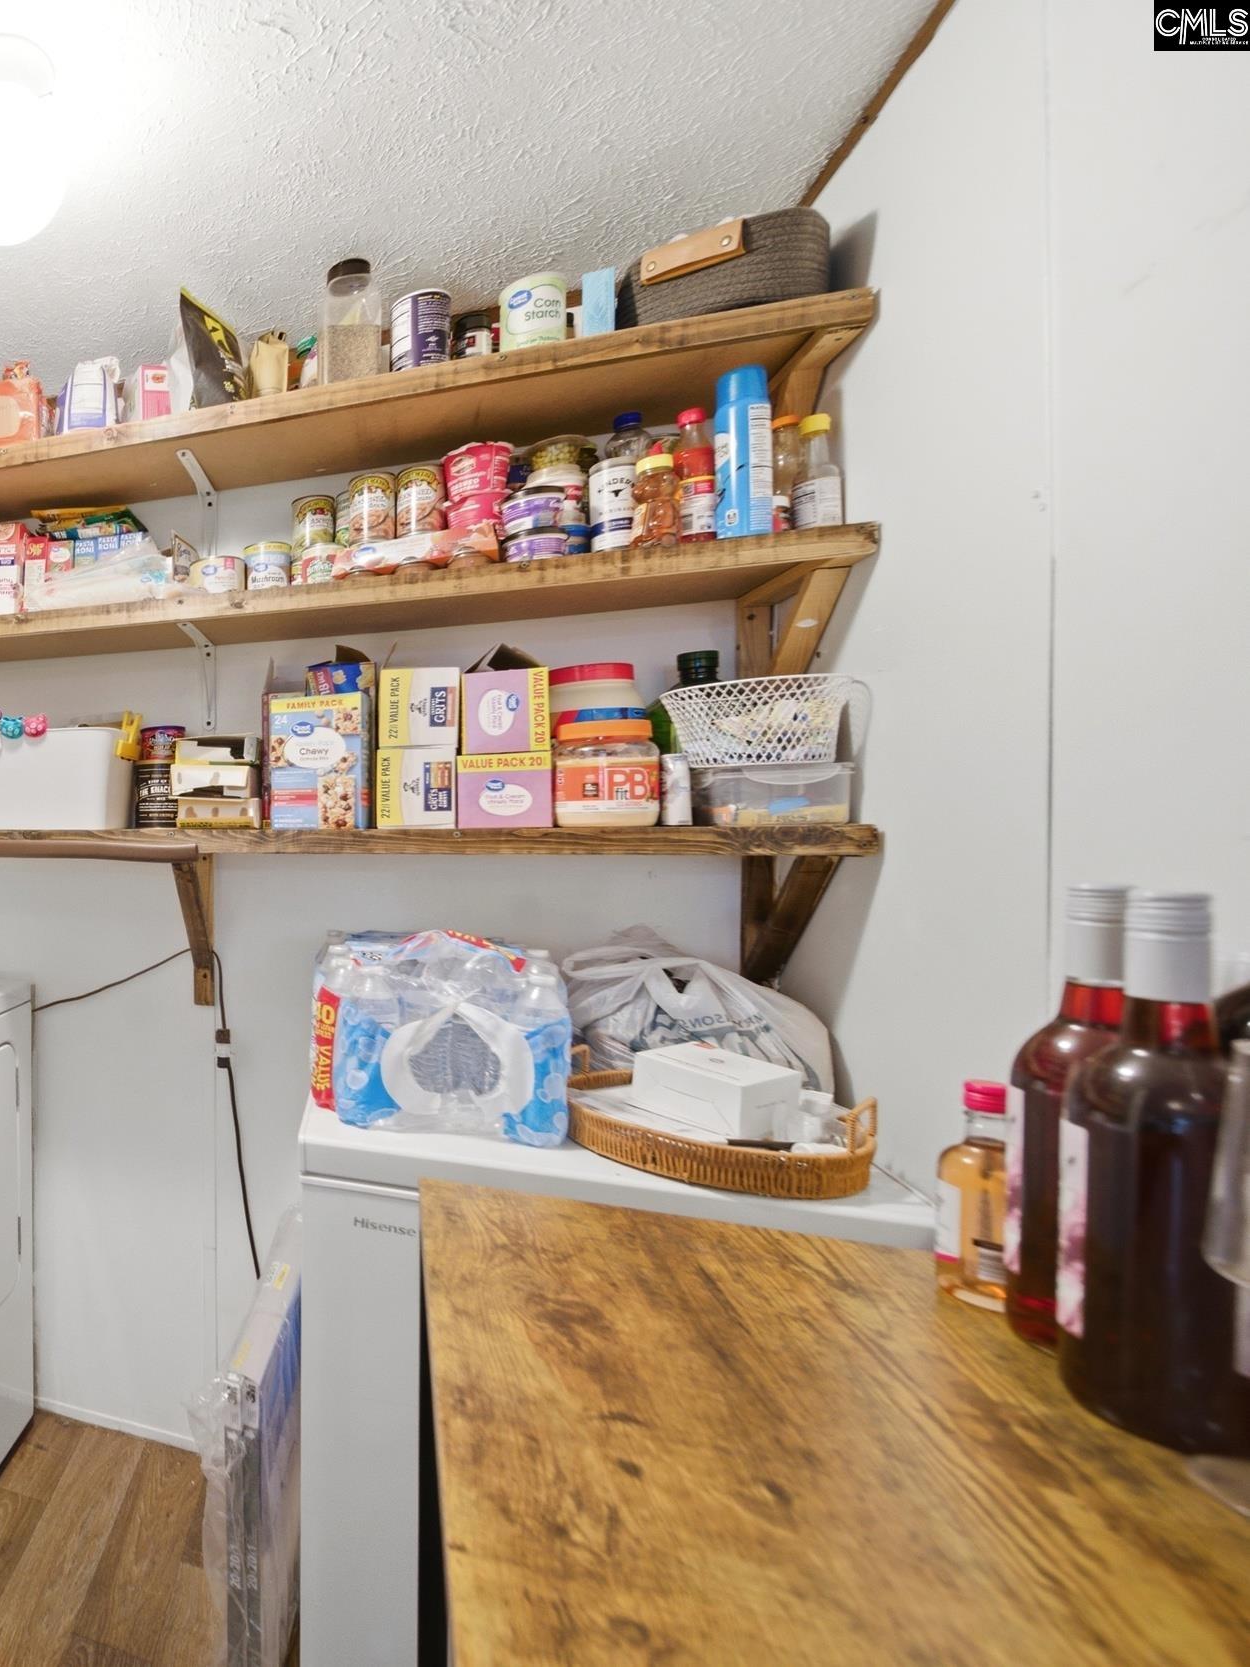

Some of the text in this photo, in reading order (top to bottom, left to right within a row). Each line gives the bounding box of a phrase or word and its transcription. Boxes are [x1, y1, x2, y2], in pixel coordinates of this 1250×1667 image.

[534, 298, 561, 308] Corn
[525, 309, 561, 321] Starch
[390, 676, 400, 695] PACK
[533, 670, 545, 700] VALUE
[286, 699, 345, 710] FAMILY PACK
[389, 697, 399, 723] VALUE
[434, 690, 447, 724] GRITS
[274, 714, 289, 726] 24
[533, 703, 546, 729] PACK
[299, 746, 329, 758] Chewy
[381, 756, 391, 774] PACK
[462, 756, 543, 769] VALUE PACK 20
[380, 777, 391, 802] VALUE
[606, 768, 648, 801] PB
[615, 787, 629, 801] fit
[315, 1044, 334, 1092] VALUE
[352, 1216, 417, 1238] Hisense
